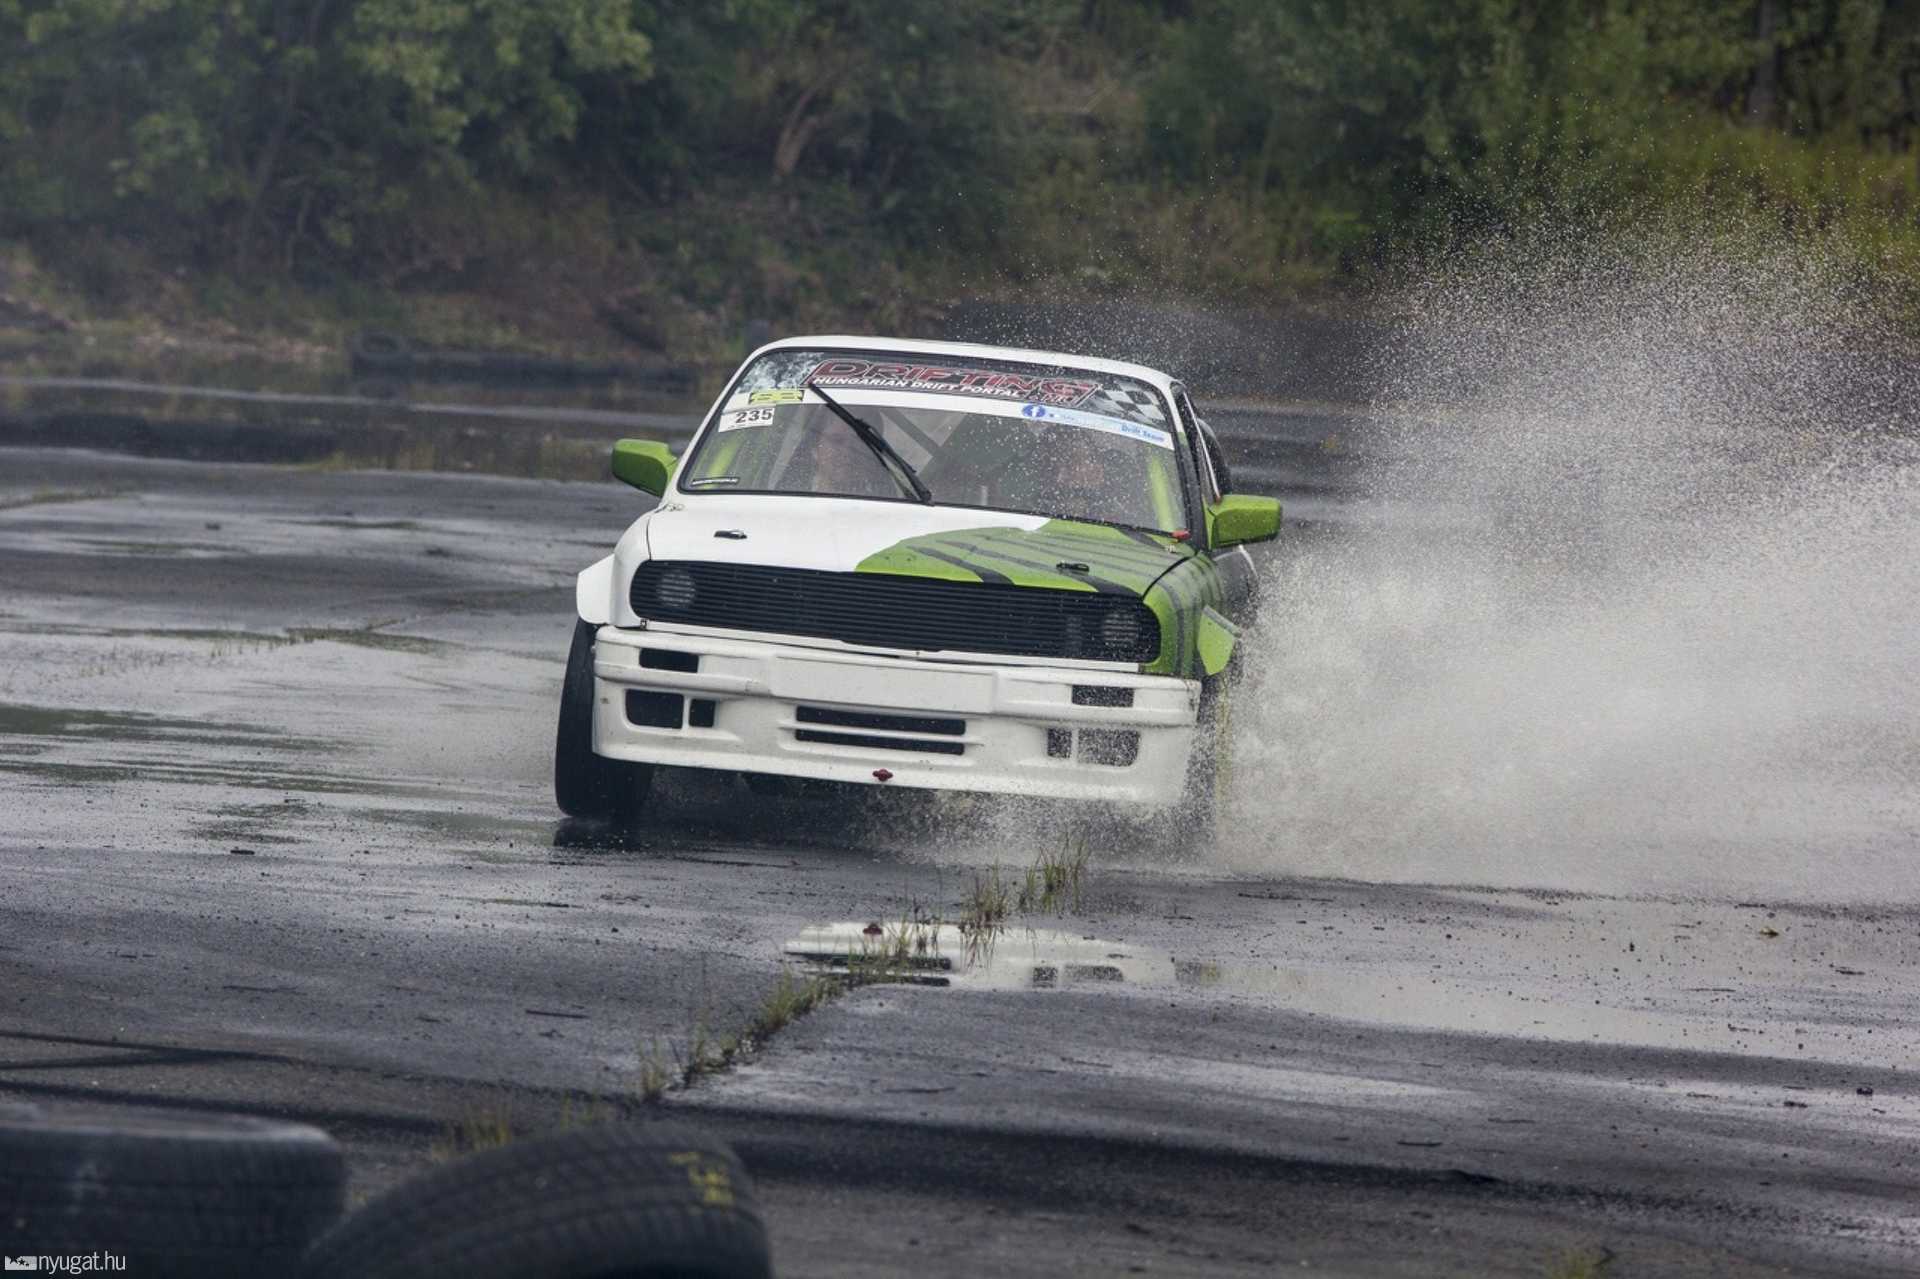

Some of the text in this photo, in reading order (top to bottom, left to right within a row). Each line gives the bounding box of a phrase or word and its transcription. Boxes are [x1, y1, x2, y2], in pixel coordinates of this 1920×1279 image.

[811, 358, 1094, 397] DRIFTING
[813, 376, 1022, 397] HUNGARIAN DRIFT PORTAL
[735, 408, 773, 424] 235
